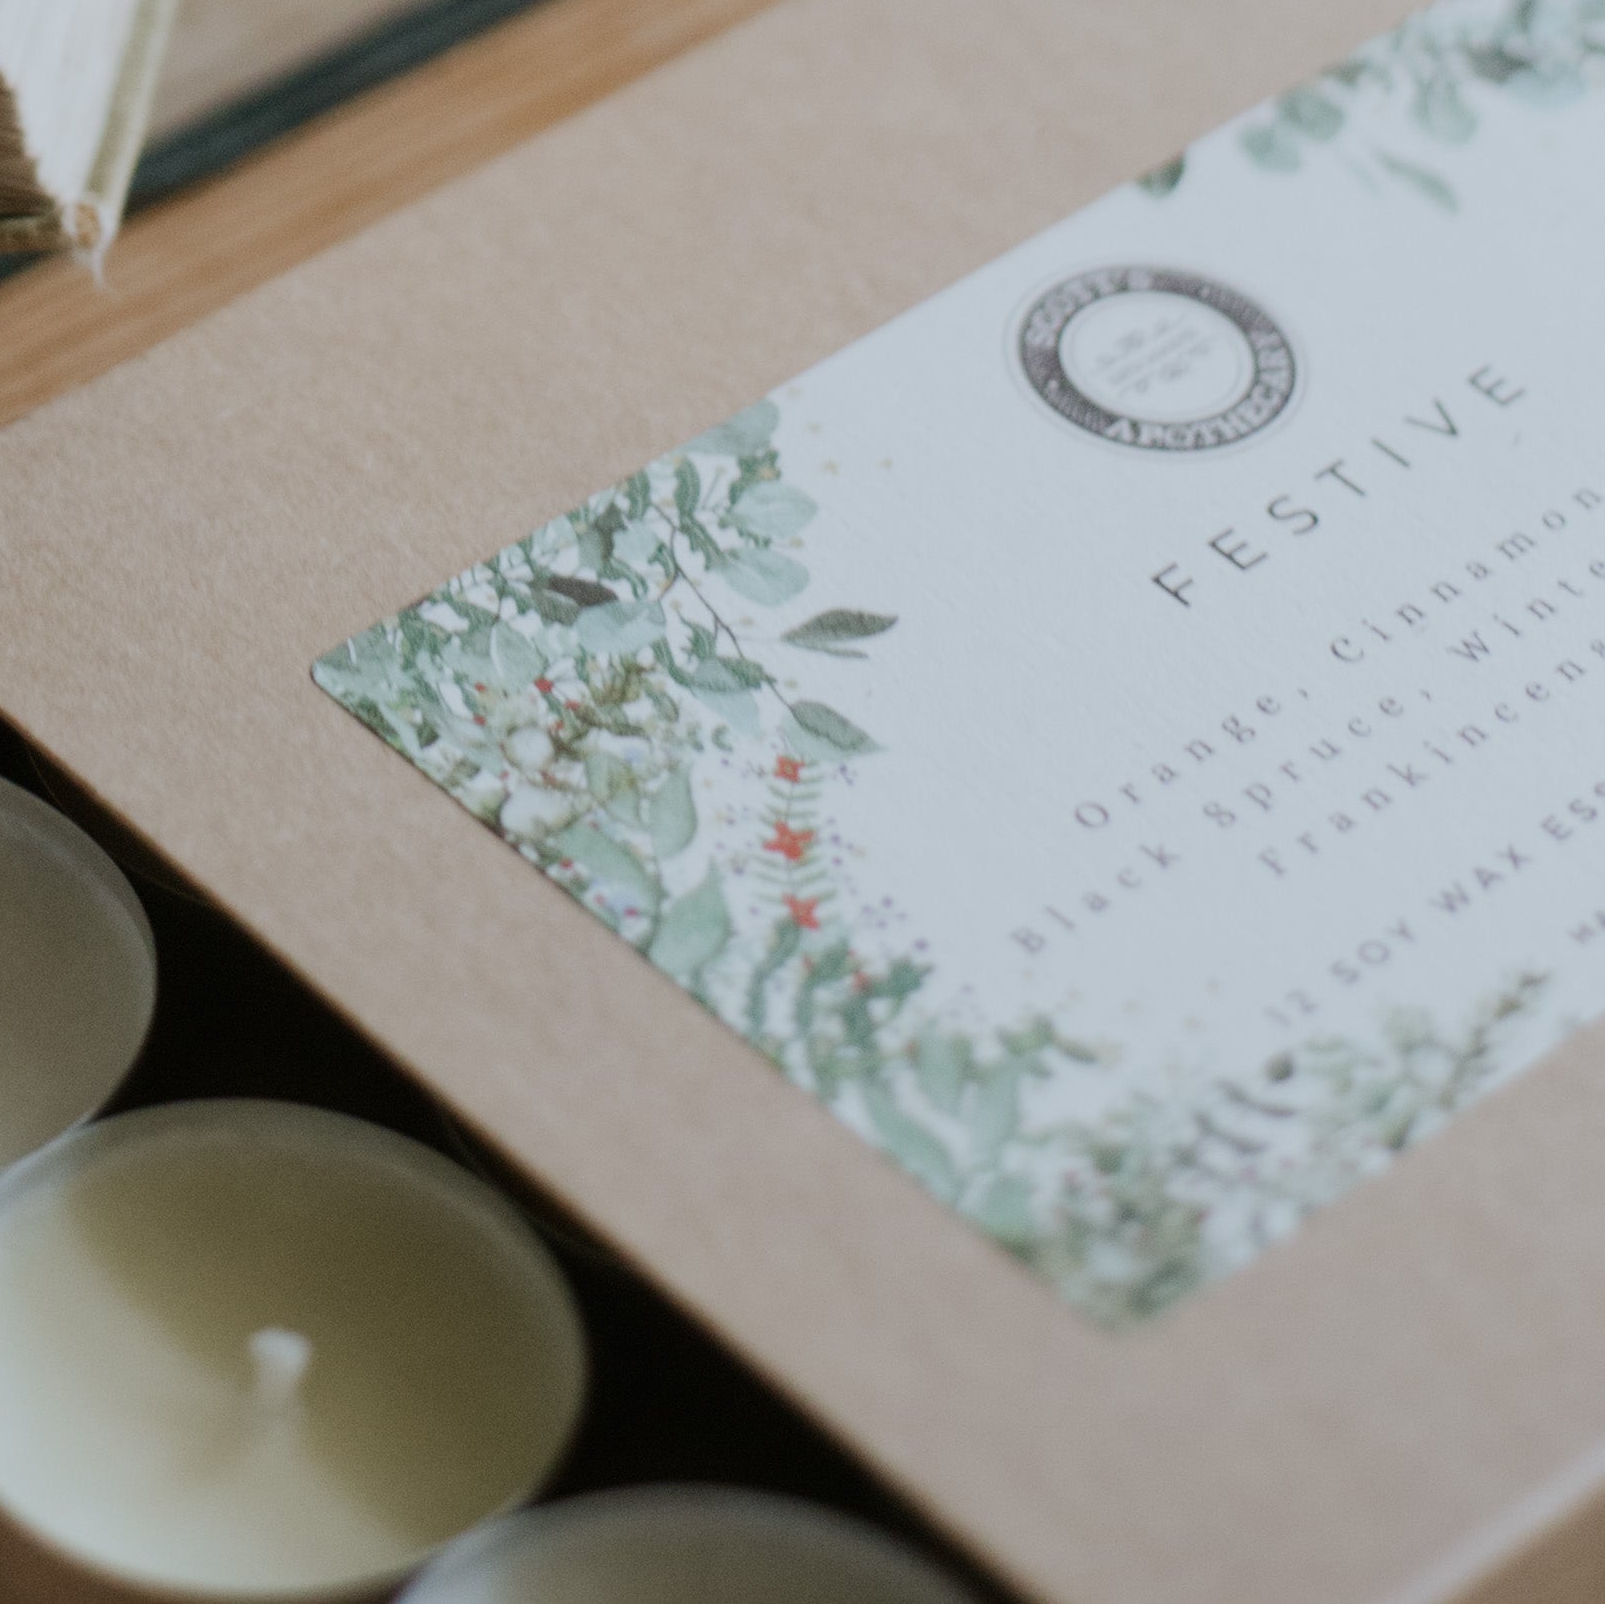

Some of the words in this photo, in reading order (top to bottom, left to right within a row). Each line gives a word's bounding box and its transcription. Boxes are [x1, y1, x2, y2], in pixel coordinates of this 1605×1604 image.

[1150, 364, 1526, 608] FESTIVE
[1074, 688, 1308, 829] Orange,
[1330, 489, 1602, 664] Cinnamon
[1009, 844, 1180, 955] Black
[1203, 689, 1433, 829] Spruce,
[1330, 918, 1417, 986] SOY
[1428, 843, 1532, 914] WAX
